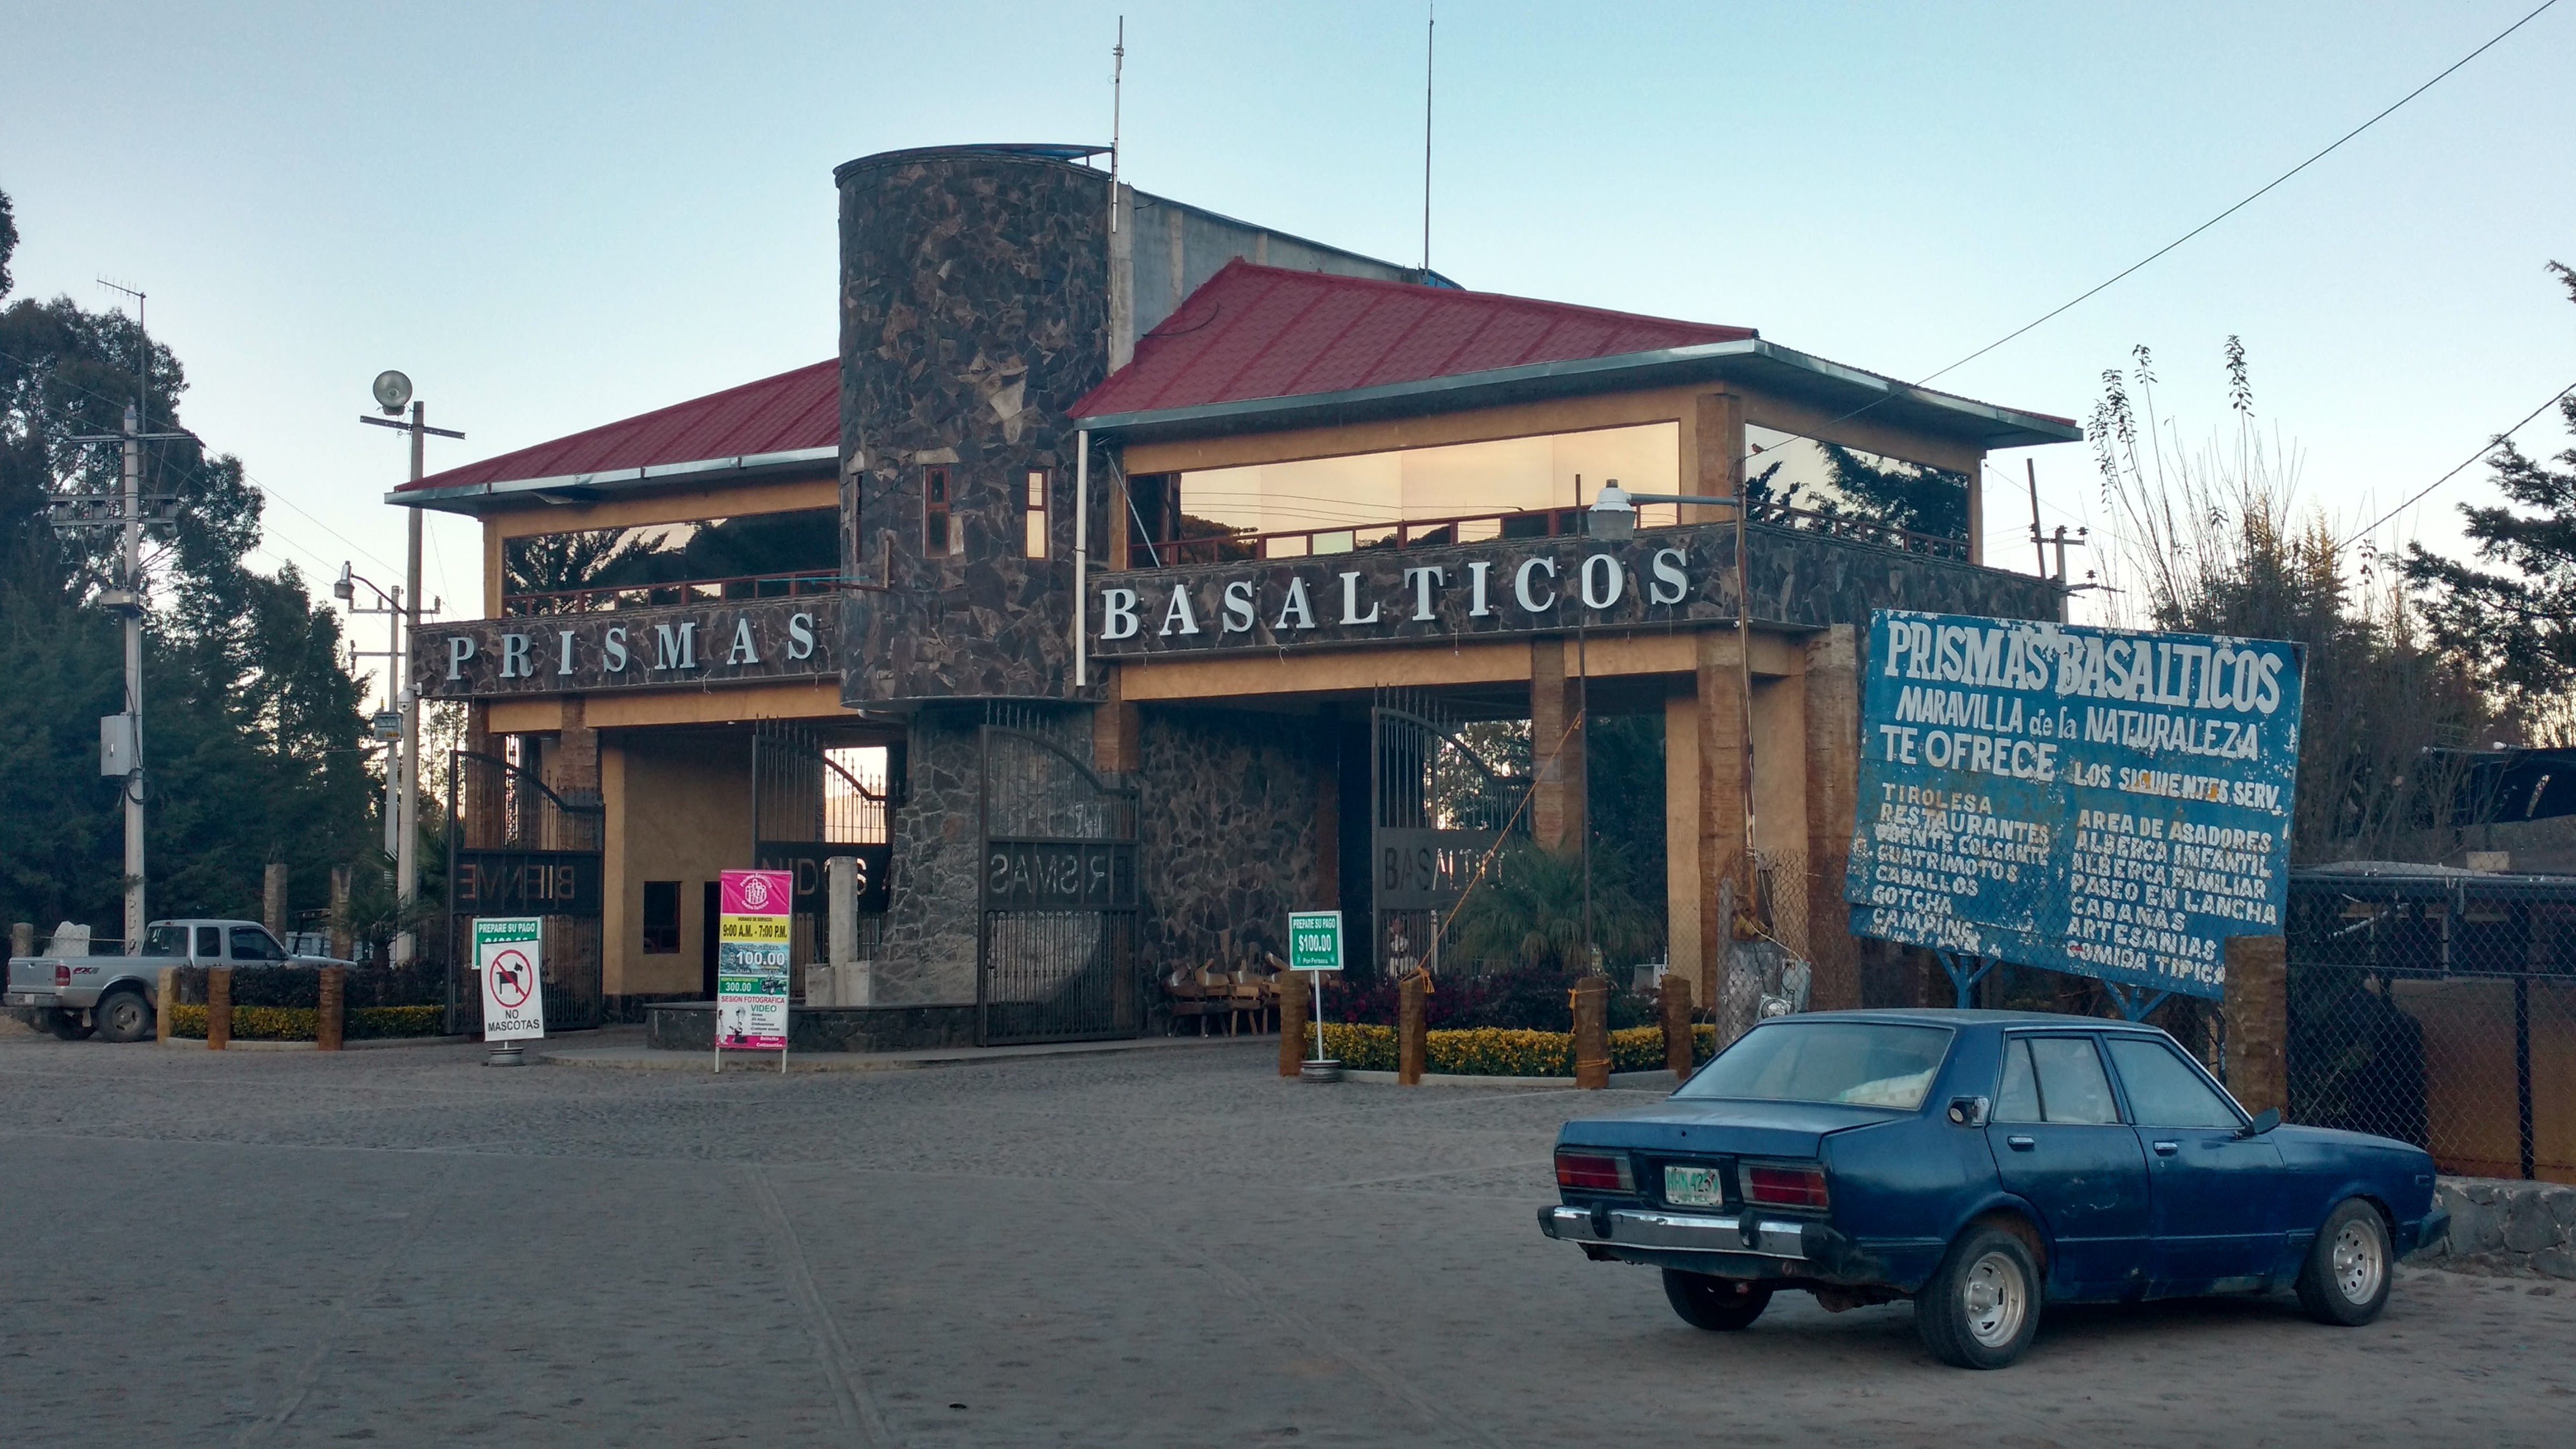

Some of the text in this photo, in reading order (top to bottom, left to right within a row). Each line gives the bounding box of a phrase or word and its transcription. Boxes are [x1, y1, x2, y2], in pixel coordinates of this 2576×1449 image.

[1101, 548, 1688, 640] BASALTICOS
[447, 613, 814, 680] PRISMAS
[1885, 621, 2284, 713] PRISMAS BASALTICOS
[1896, 685, 2258, 761] MARAVILLA de la NATURALEZA
[1880, 724, 2058, 781] TE OFRECE
[1882, 782, 1993, 815] TIROLESA
[2074, 762, 2111, 788] LOS
[2232, 781, 2282, 811] SERV.
[1880, 803, 2050, 844] RESTAURANTES
[2077, 809, 2272, 853] AREA DE ASADORES
[1878, 844, 2018, 883] CUATRIMOTOS
[2075, 830, 2273, 879] ALBERCA INFANTIL
[1876, 865, 1979, 896] CABALLOS
[2072, 852, 2266, 901] ALBERCA FAMILIAR
[1872, 884, 1952, 914] GOTCHA
[2070, 873, 2277, 926] PASEO EN LANCHA
[478, 923, 535, 933] PREPARE SU PAGO
[723, 924, 737, 936] 9:00
[738, 925, 753, 937] A.M.
[759, 925, 773, 938] 7:00
[774, 925, 787, 938] P.M.
[1293, 918, 1335, 929] PREPARE SU PAGO
[1873, 908, 1975, 938] CAMPING
[2066, 916, 2218, 961] ARTESANIAS
[729, 952, 785, 965] $100.00
[1298, 934, 1331, 954] $100.00
[2067, 940, 2147, 972] COMIDA
[726, 982, 751, 992] 300.00
[488, 1019, 539, 1032] MASCOTAS
[506, 1009, 519, 1019] NO
